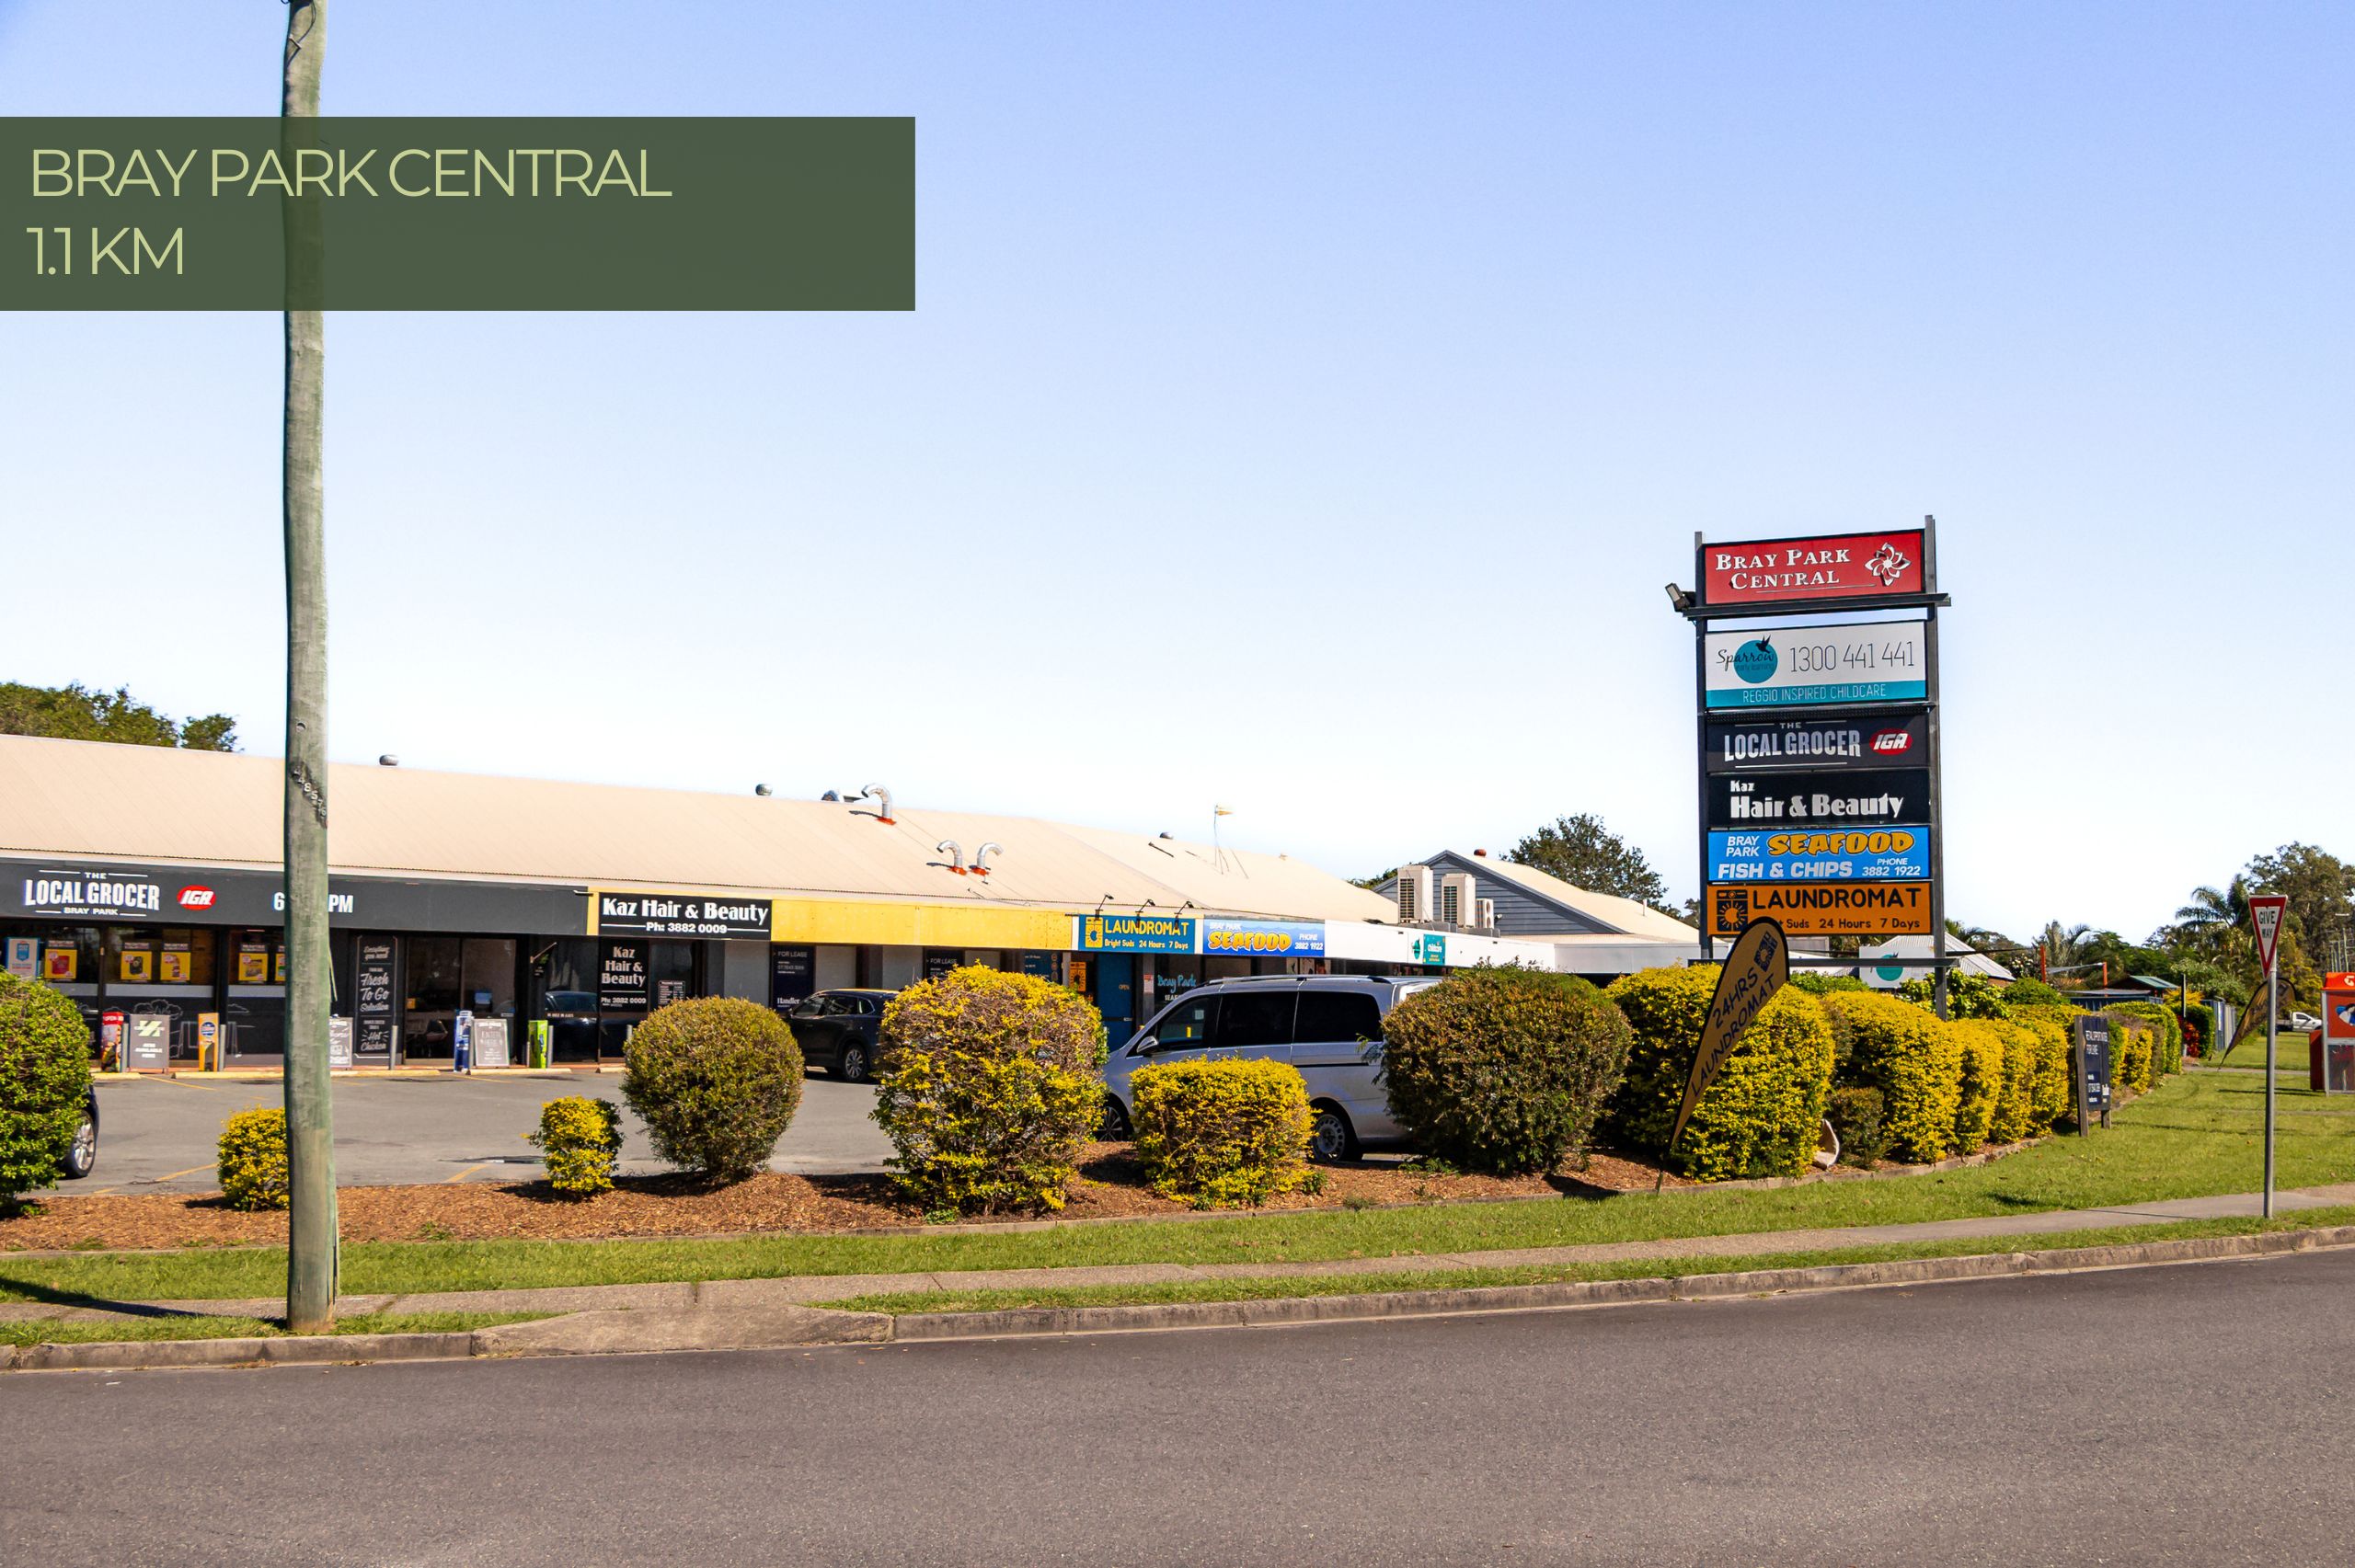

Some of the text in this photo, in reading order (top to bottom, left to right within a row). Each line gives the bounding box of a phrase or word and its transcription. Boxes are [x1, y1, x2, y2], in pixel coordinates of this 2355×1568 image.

[1716, 549, 1851, 570] BRAY PARK
[1731, 570, 1840, 589] CENTRAL
[1716, 649, 1775, 671] Sparrow
[1789, 641, 1914, 672] 1300 441 441
[1743, 683, 1886, 703] REGGIO INSPIRED CHILDCARE
[1724, 729, 1908, 762] LOCAL GROCER IGA
[1730, 781, 1755, 792] Kaz
[1730, 793, 1904, 818] Hair & Beauty
[1728, 830, 1915, 856] BRAY SEAFOOD
[1726, 847, 1760, 857] PARK
[1877, 857, 1908, 865] PHONE
[1717, 861, 1853, 879] FISH & CHIPS
[1862, 865, 1921, 876] 3882 1922
[25, 879, 213, 910] LOCAL GROCER IGA
[1752, 887, 1922, 910] LAUNDROMAT
[603, 898, 768, 925] Kaz Hair & Beauty
[2259, 911, 2275, 924] GIVE
[646, 921, 728, 933] Ph: 3882 0009
[1105, 920, 1189, 935] LAUNDROMAT
[1210, 921, 1241, 931] BRAY PARK
[1786, 920, 1809, 929] Suds
[1819, 919, 1834, 929] 24
[1839, 919, 1871, 929] Hours
[1880, 919, 1889, 929] 7
[1891, 919, 1920, 931] Days
[2262, 929, 2272, 938] WAY
[1105, 938, 1120, 948] Bright
[1122, 939, 1134, 947] Suds
[1175, 941, 1189, 950] Days
[1208, 931, 1292, 952] SEAFOOD
[1294, 942, 1324, 951] 3882 1922
[613, 946, 635, 958] Kaz
[605, 960, 643, 972] Hair &
[360, 972, 388, 986] Fresh
[602, 973, 646, 988] Beauty
[1157, 975, 1197, 993] Bray Park
[360, 987, 390, 1001] To Go
[1712, 967, 1759, 1029] 24HRS
[360, 1001, 389, 1013] Selection
[367, 1032, 382, 1041] Hot
[1691, 973, 1775, 1097] LAUNDROMAT
